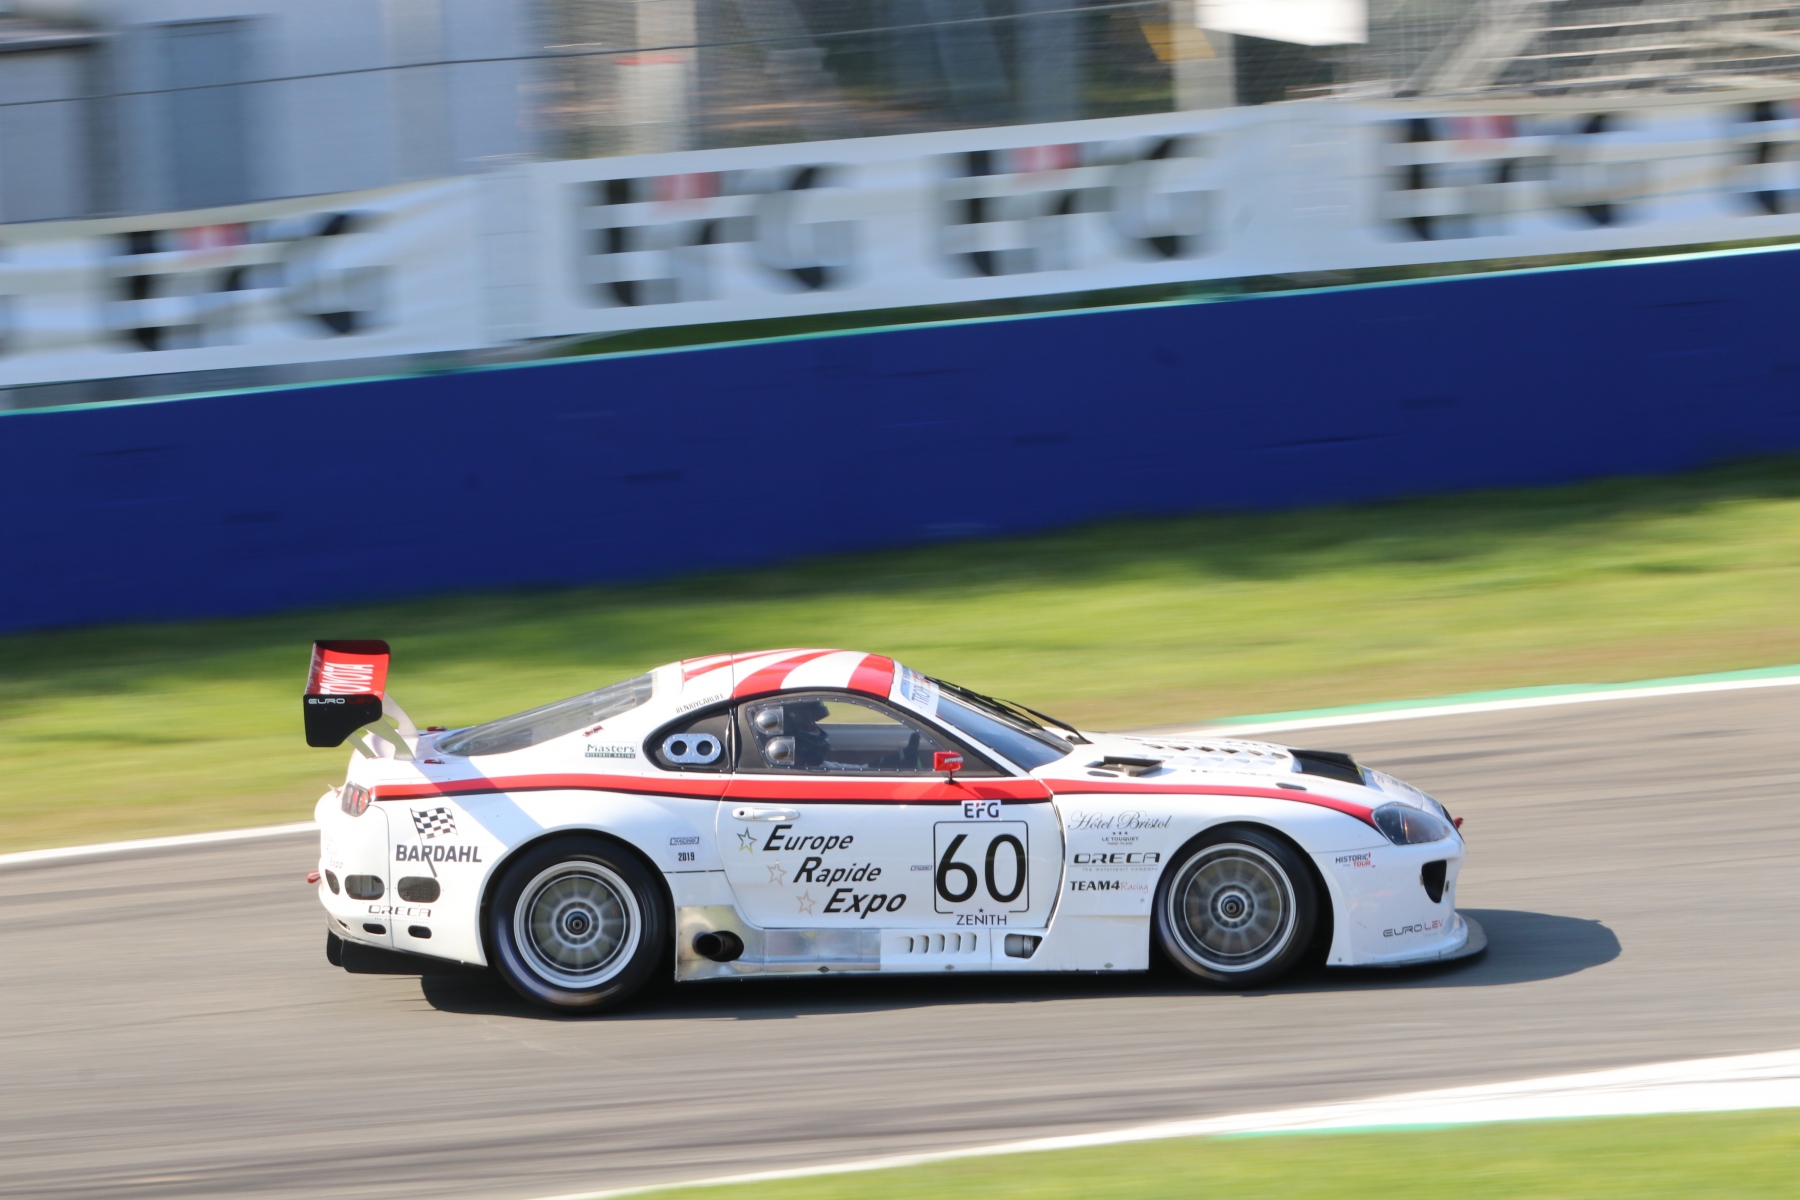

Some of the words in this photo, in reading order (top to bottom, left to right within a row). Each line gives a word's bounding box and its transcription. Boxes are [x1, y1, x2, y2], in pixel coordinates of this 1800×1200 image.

[587, 743, 635, 753] Masters
[964, 802, 999, 818] EFG
[1116, 810, 1172, 829] Bristol
[762, 824, 854, 854] Europe
[395, 844, 482, 862] BARDAHL
[678, 851, 695, 861] 2019
[1073, 852, 1161, 864] ORECA
[1335, 853, 1369, 864] HISTORIC
[793, 856, 882, 887] Rapide
[936, 834, 1026, 903] 60
[368, 905, 432, 918] ORECA
[823, 888, 907, 919] Expo
[956, 914, 1007, 926] ZENITH
